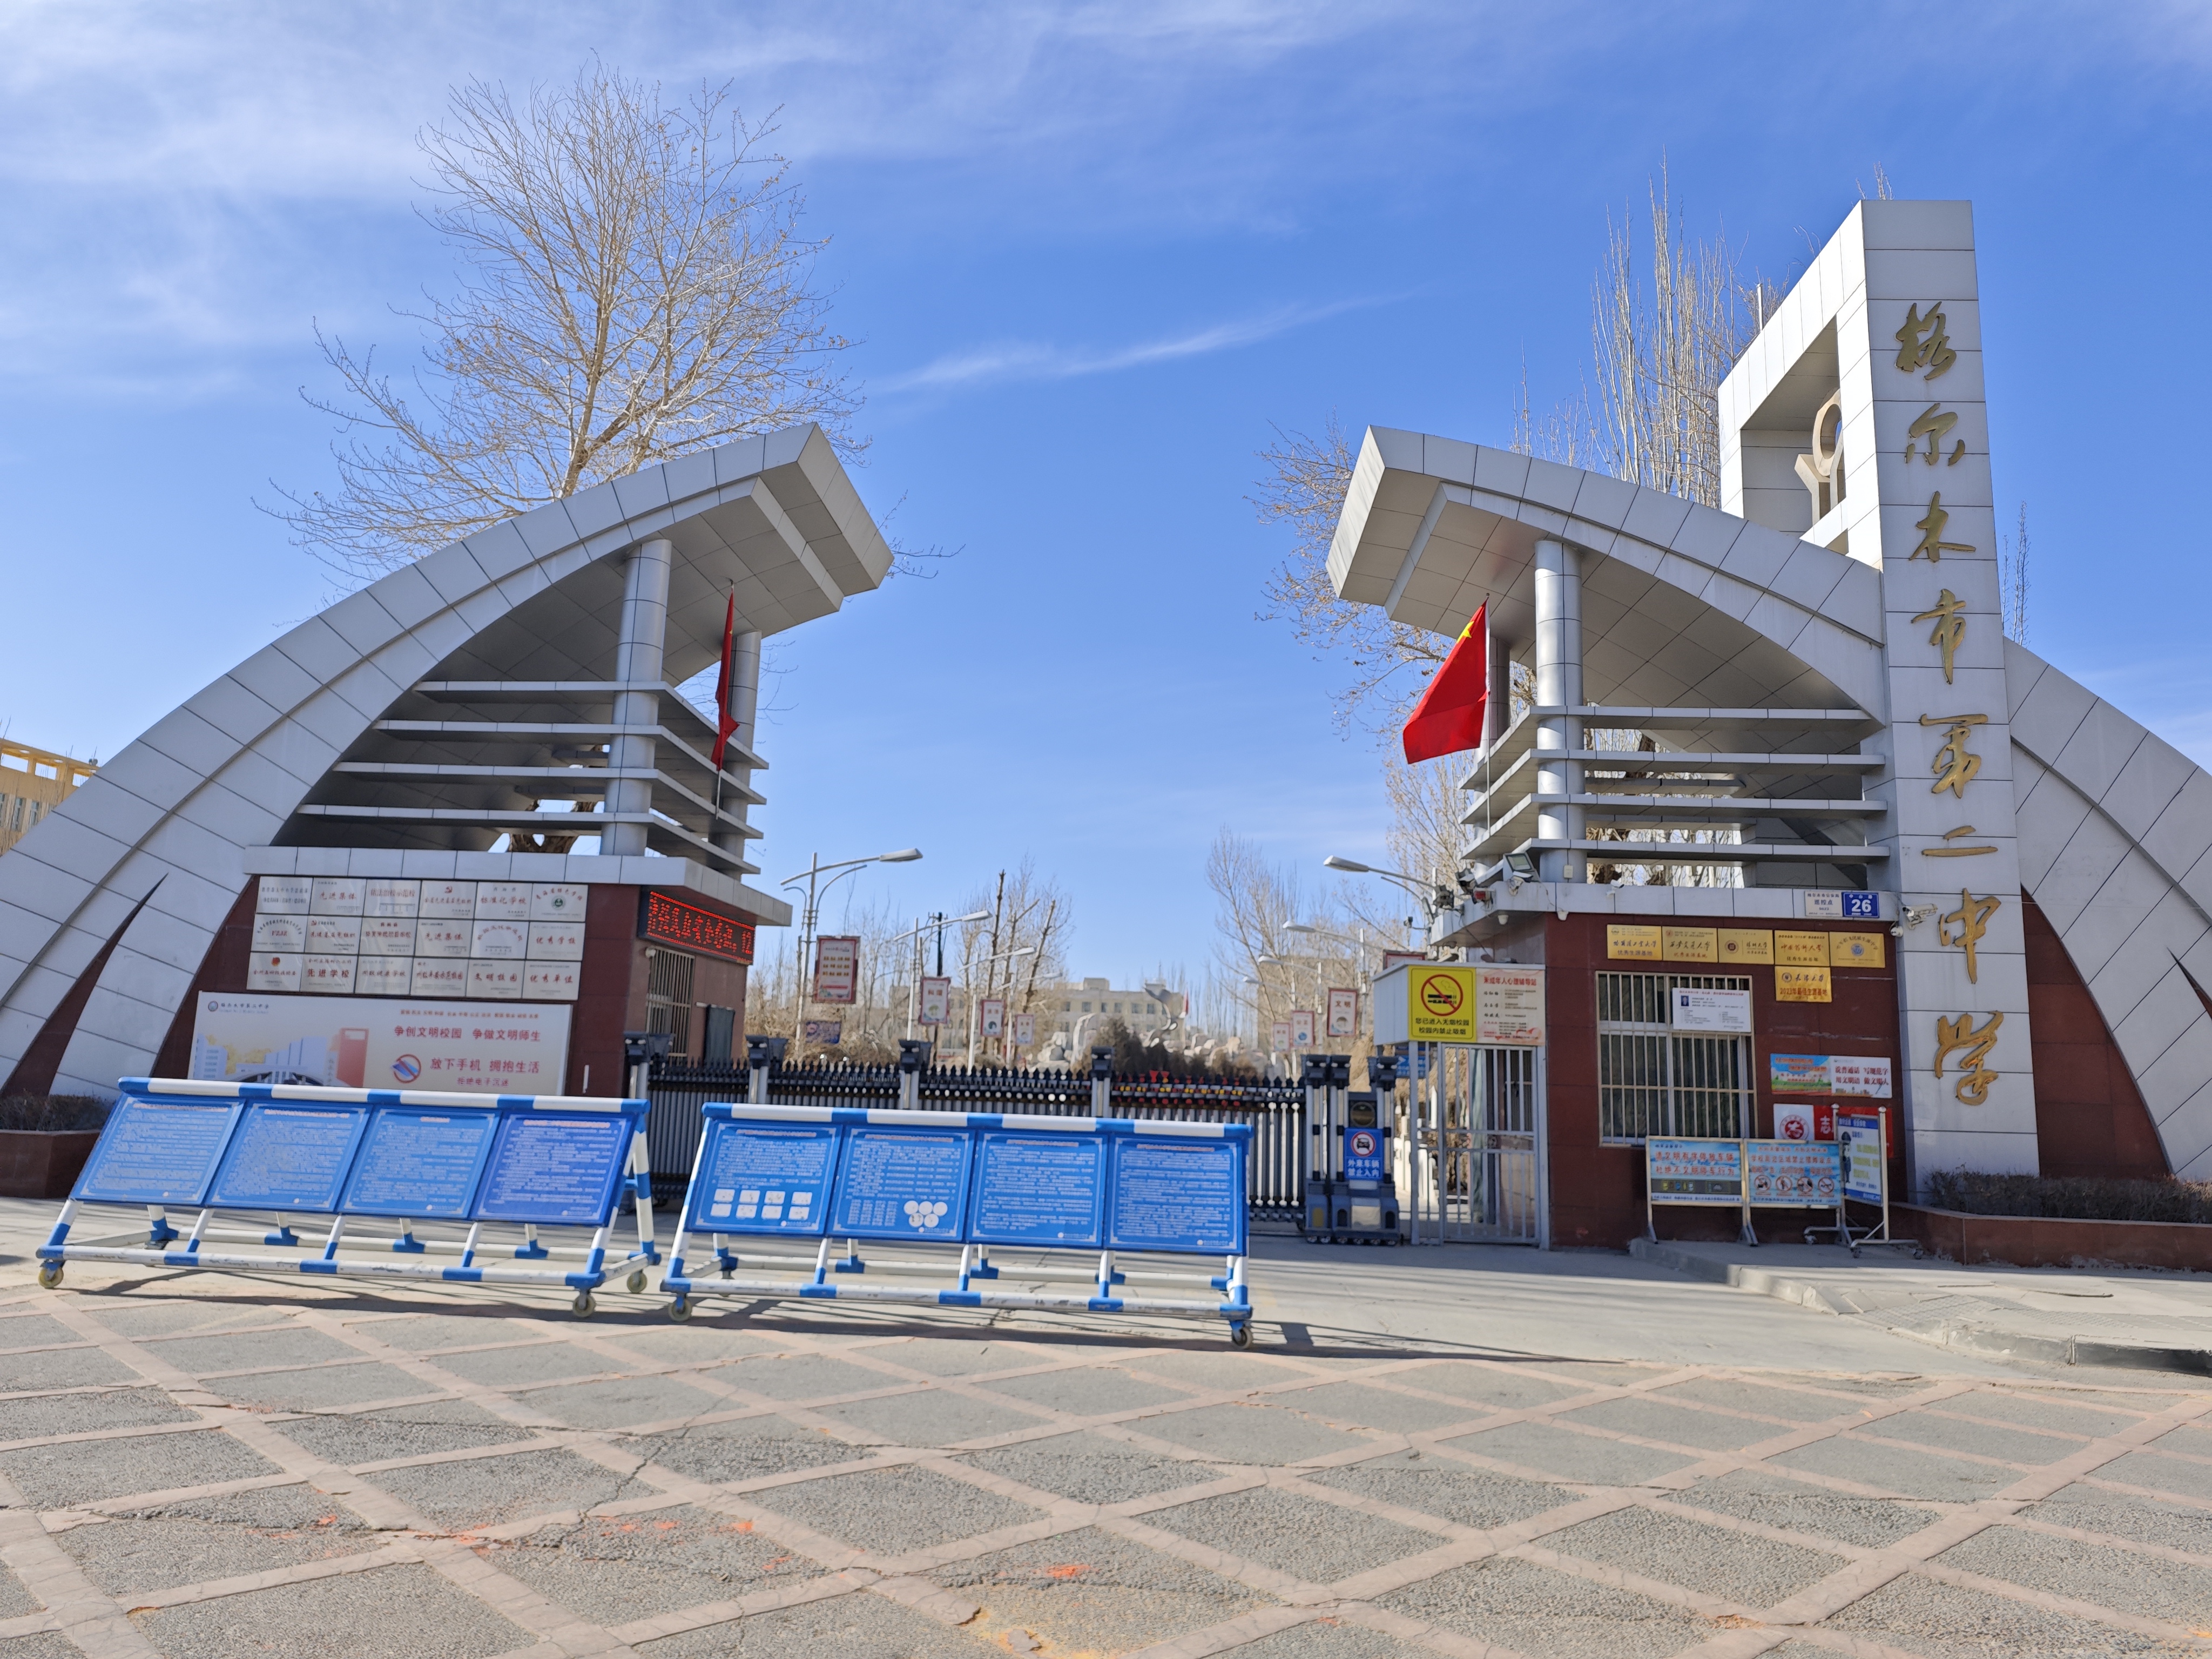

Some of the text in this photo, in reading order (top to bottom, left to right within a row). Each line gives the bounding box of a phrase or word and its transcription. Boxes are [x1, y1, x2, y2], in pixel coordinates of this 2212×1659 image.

[1894, 301, 2004, 1105] 格尔木市第二中学
[319, 892, 358, 901] 先进集体
[1851, 899, 1872, 913] 26
[425, 932, 463, 941] 先进集体
[307, 968, 350, 979] 先进学校
[474, 972, 518, 982] 文明校园
[1483, 976, 1537, 986] 未成年人心理辅导站
[1415, 1017, 1469, 1026] 您已进入无烟校园
[394, 1026, 541, 1042] 争创文明校园 争做文明师生
[1418, 1027, 1466, 1035] 校园内禁止吸烟
[430, 1057, 540, 1074] 放下手机 拥抱生活
[1347, 1168, 1380, 1177] 禁止入内
